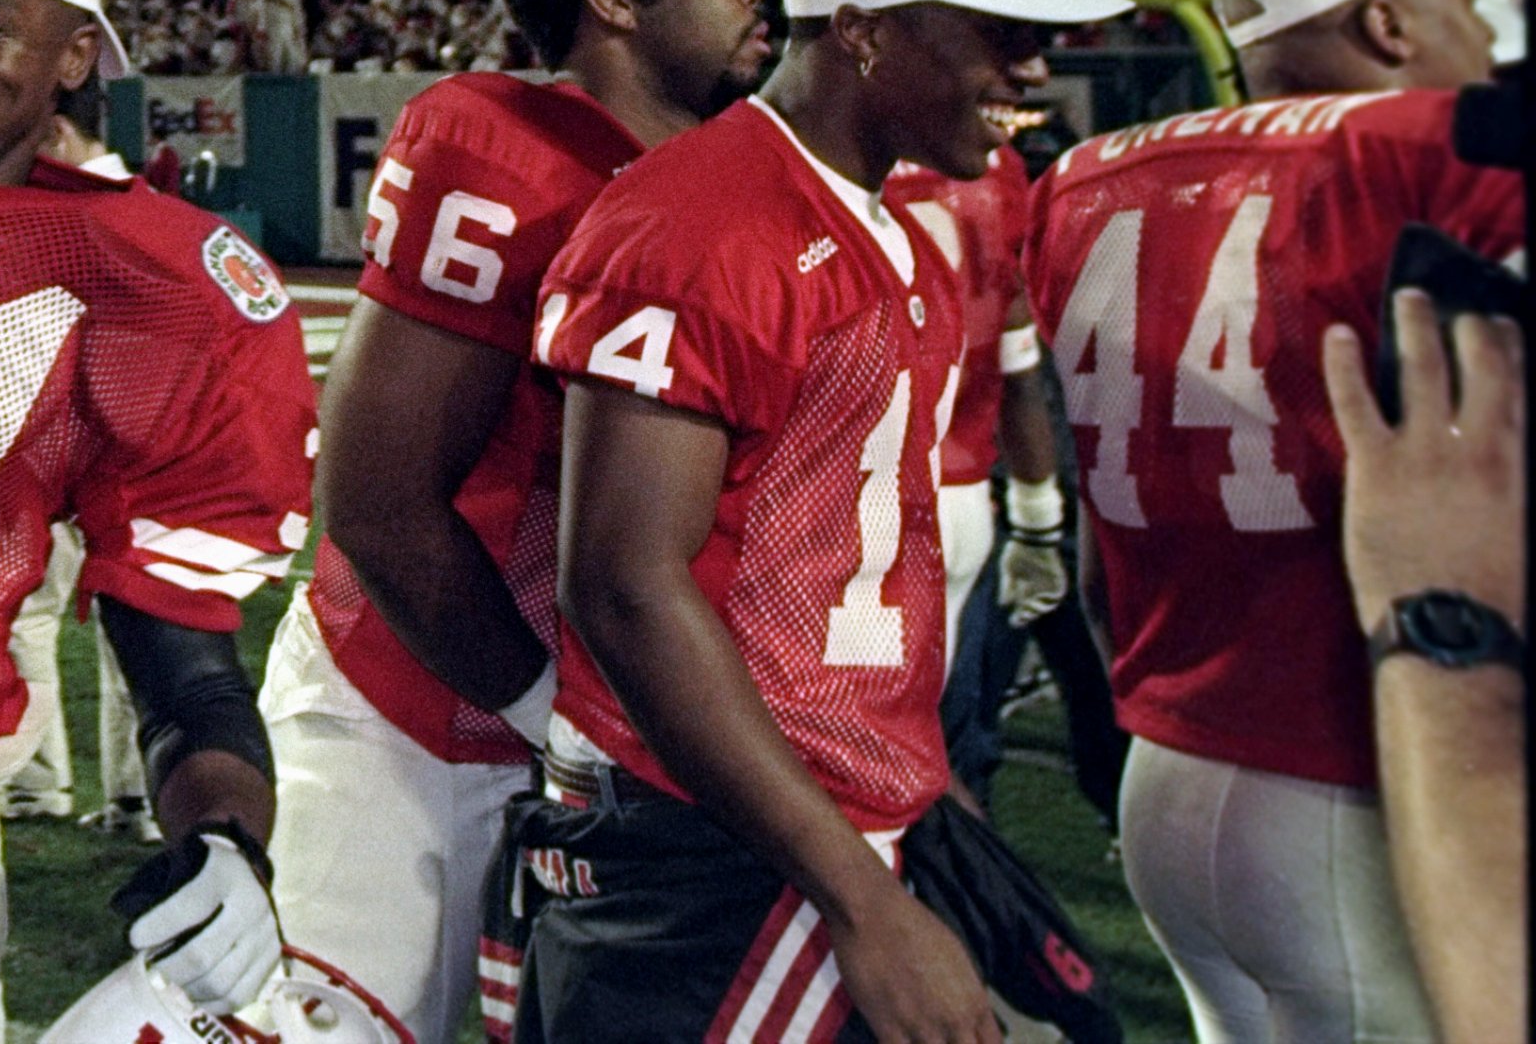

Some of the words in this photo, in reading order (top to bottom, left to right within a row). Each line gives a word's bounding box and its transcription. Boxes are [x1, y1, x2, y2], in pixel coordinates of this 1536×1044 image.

[150, 96, 237, 135] FedEx
[362, 158, 518, 303] 56
[797, 235, 839, 274] adidas
[535, 293, 677, 398] 14
[1053, 192, 1317, 533] 44
